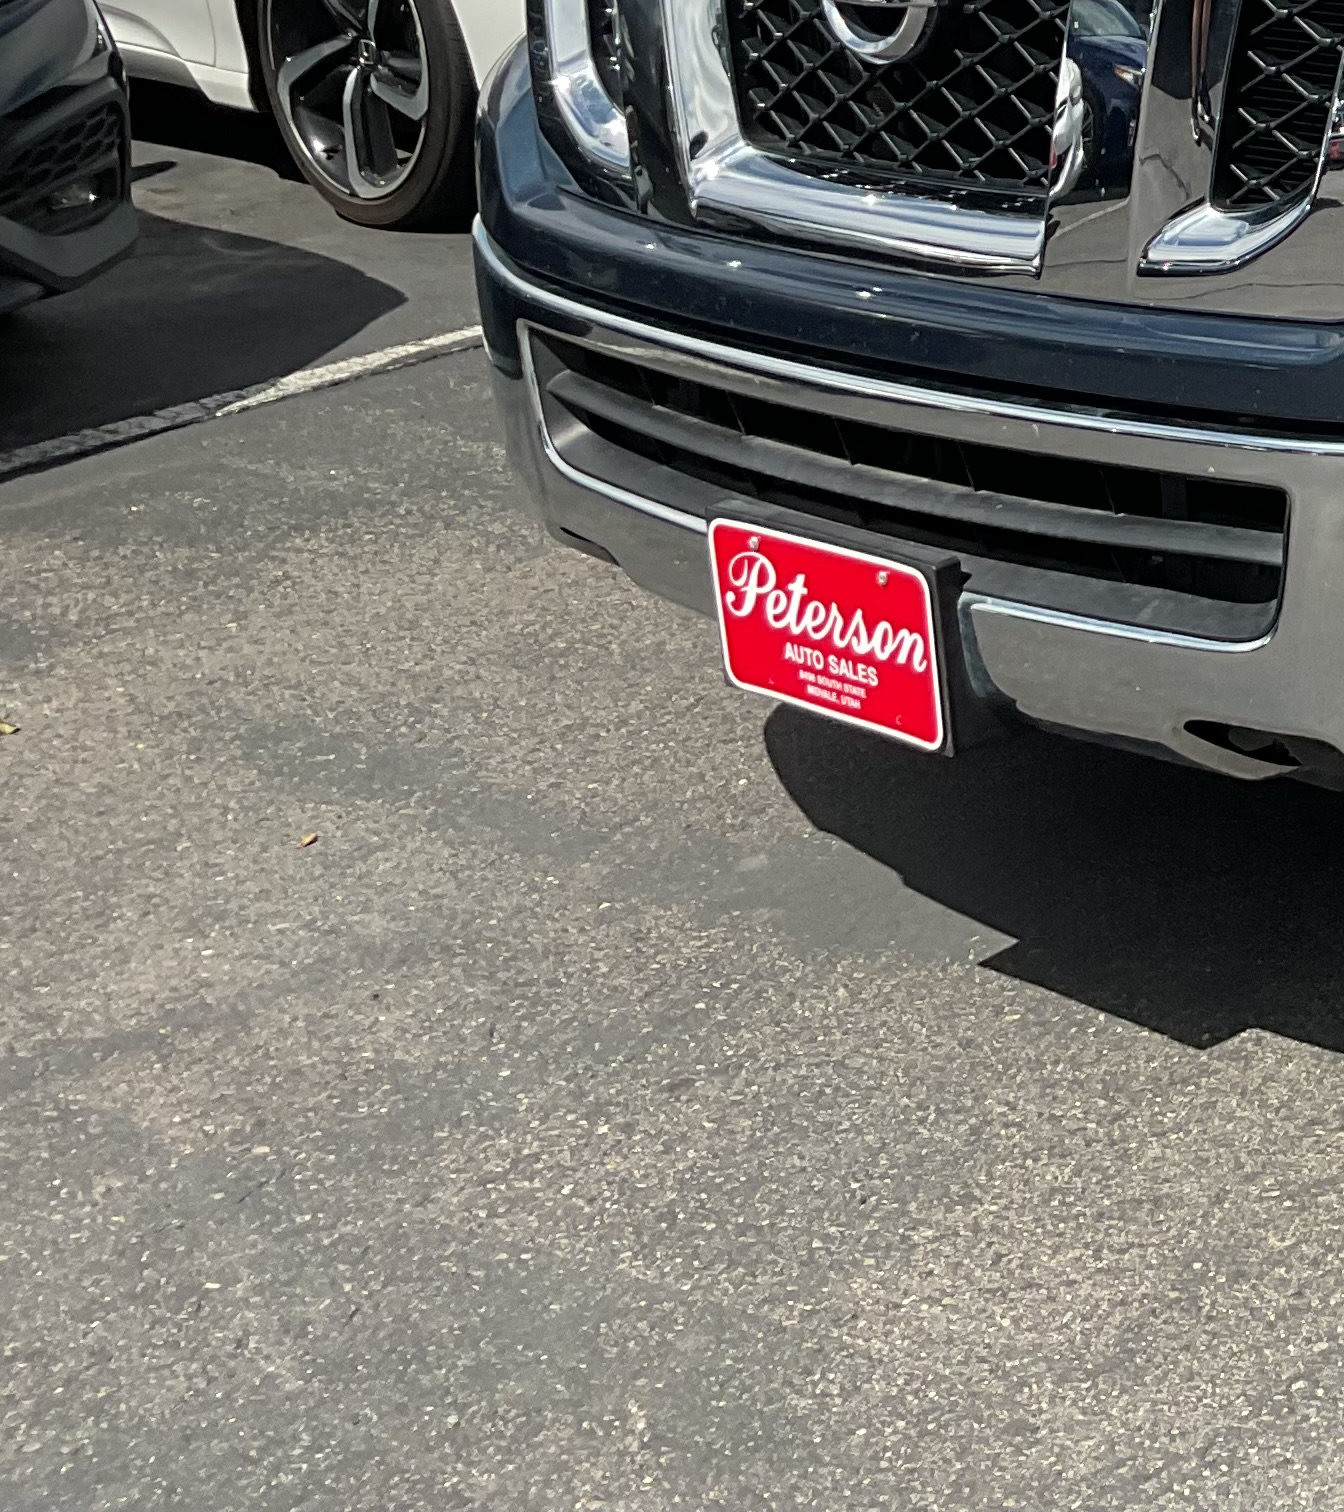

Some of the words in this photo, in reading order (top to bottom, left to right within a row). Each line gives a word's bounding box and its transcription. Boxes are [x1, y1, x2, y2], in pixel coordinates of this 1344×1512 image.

[726, 551, 927, 672] Peterson
[784, 642, 824, 670] AUTO
[828, 654, 878, 686] SALES
[843, 683, 867, 699] STATE
